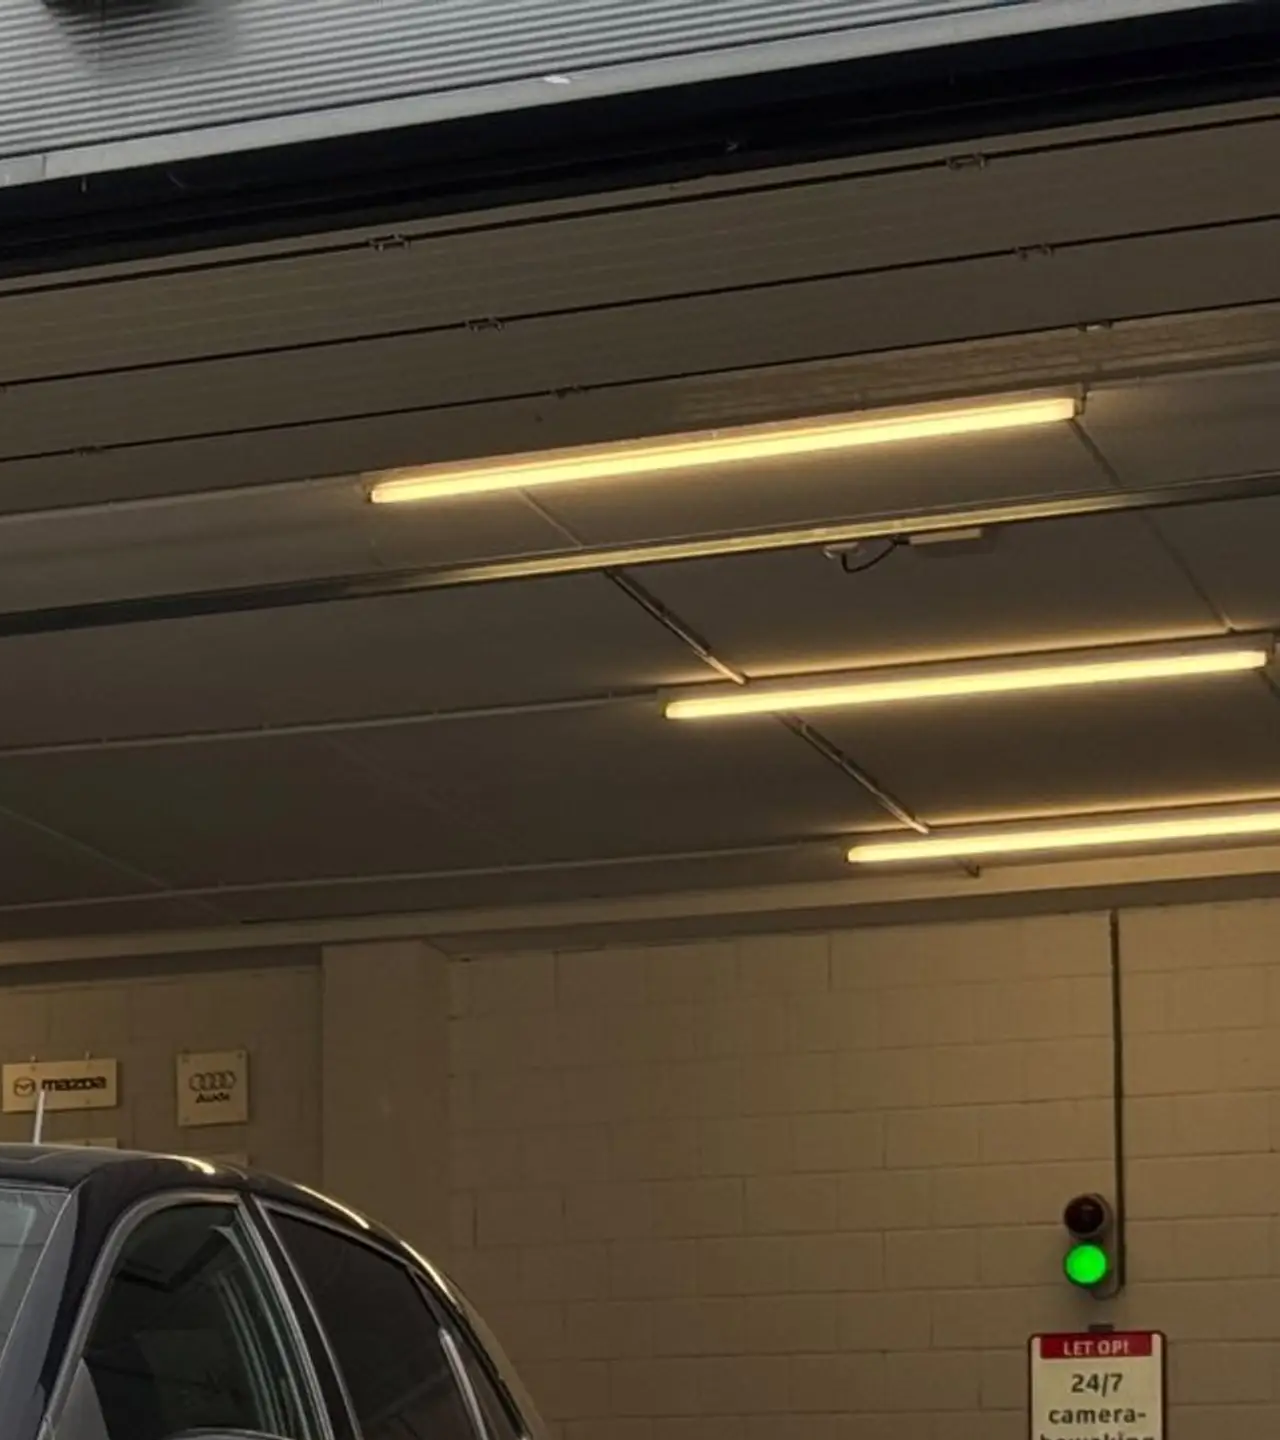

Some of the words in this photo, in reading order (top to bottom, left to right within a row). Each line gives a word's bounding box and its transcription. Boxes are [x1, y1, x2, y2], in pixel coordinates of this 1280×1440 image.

[1063, 1341, 1091, 1356] LET
[1097, 1340, 1129, 1355] OP!
[1071, 1373, 1123, 1397] 24/7
[1048, 1406, 1146, 1425] camera-
